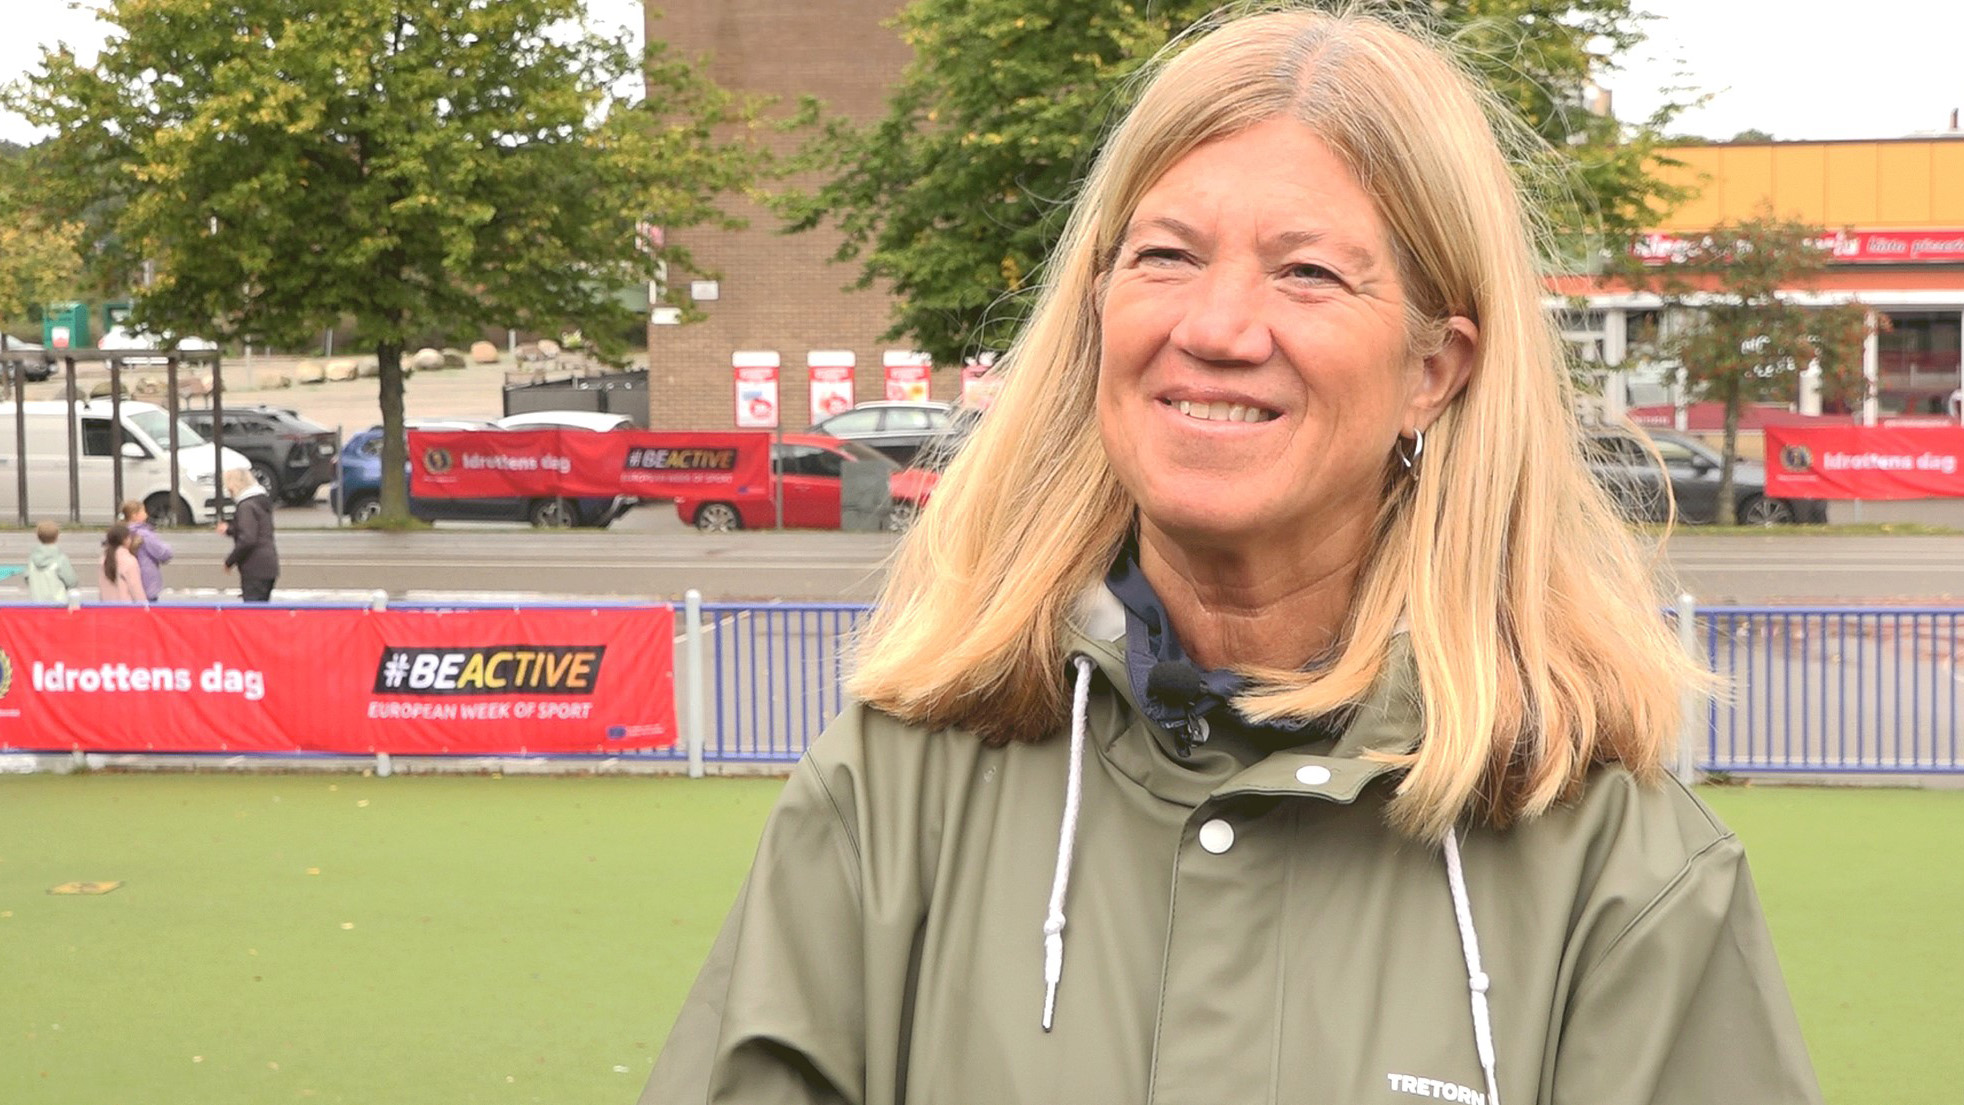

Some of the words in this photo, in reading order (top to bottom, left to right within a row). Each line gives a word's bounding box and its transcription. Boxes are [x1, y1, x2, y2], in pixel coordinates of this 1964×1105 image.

[462, 452, 538, 471] Idrottens
[541, 453, 571, 473] dag
[1823, 452, 1914, 470] Idrottens
[1917, 453, 1957, 474] dag
[32, 661, 192, 692] Idrottens
[200, 662, 265, 700] dag
[384, 653, 596, 689] #BEACTIVE
[367, 701, 457, 720] EUROPEAN
[460, 703, 511, 720] WEEK
[513, 701, 538, 719] OF
[538, 701, 593, 720] SPORT
[1387, 1073, 1486, 1105] TRETORN
